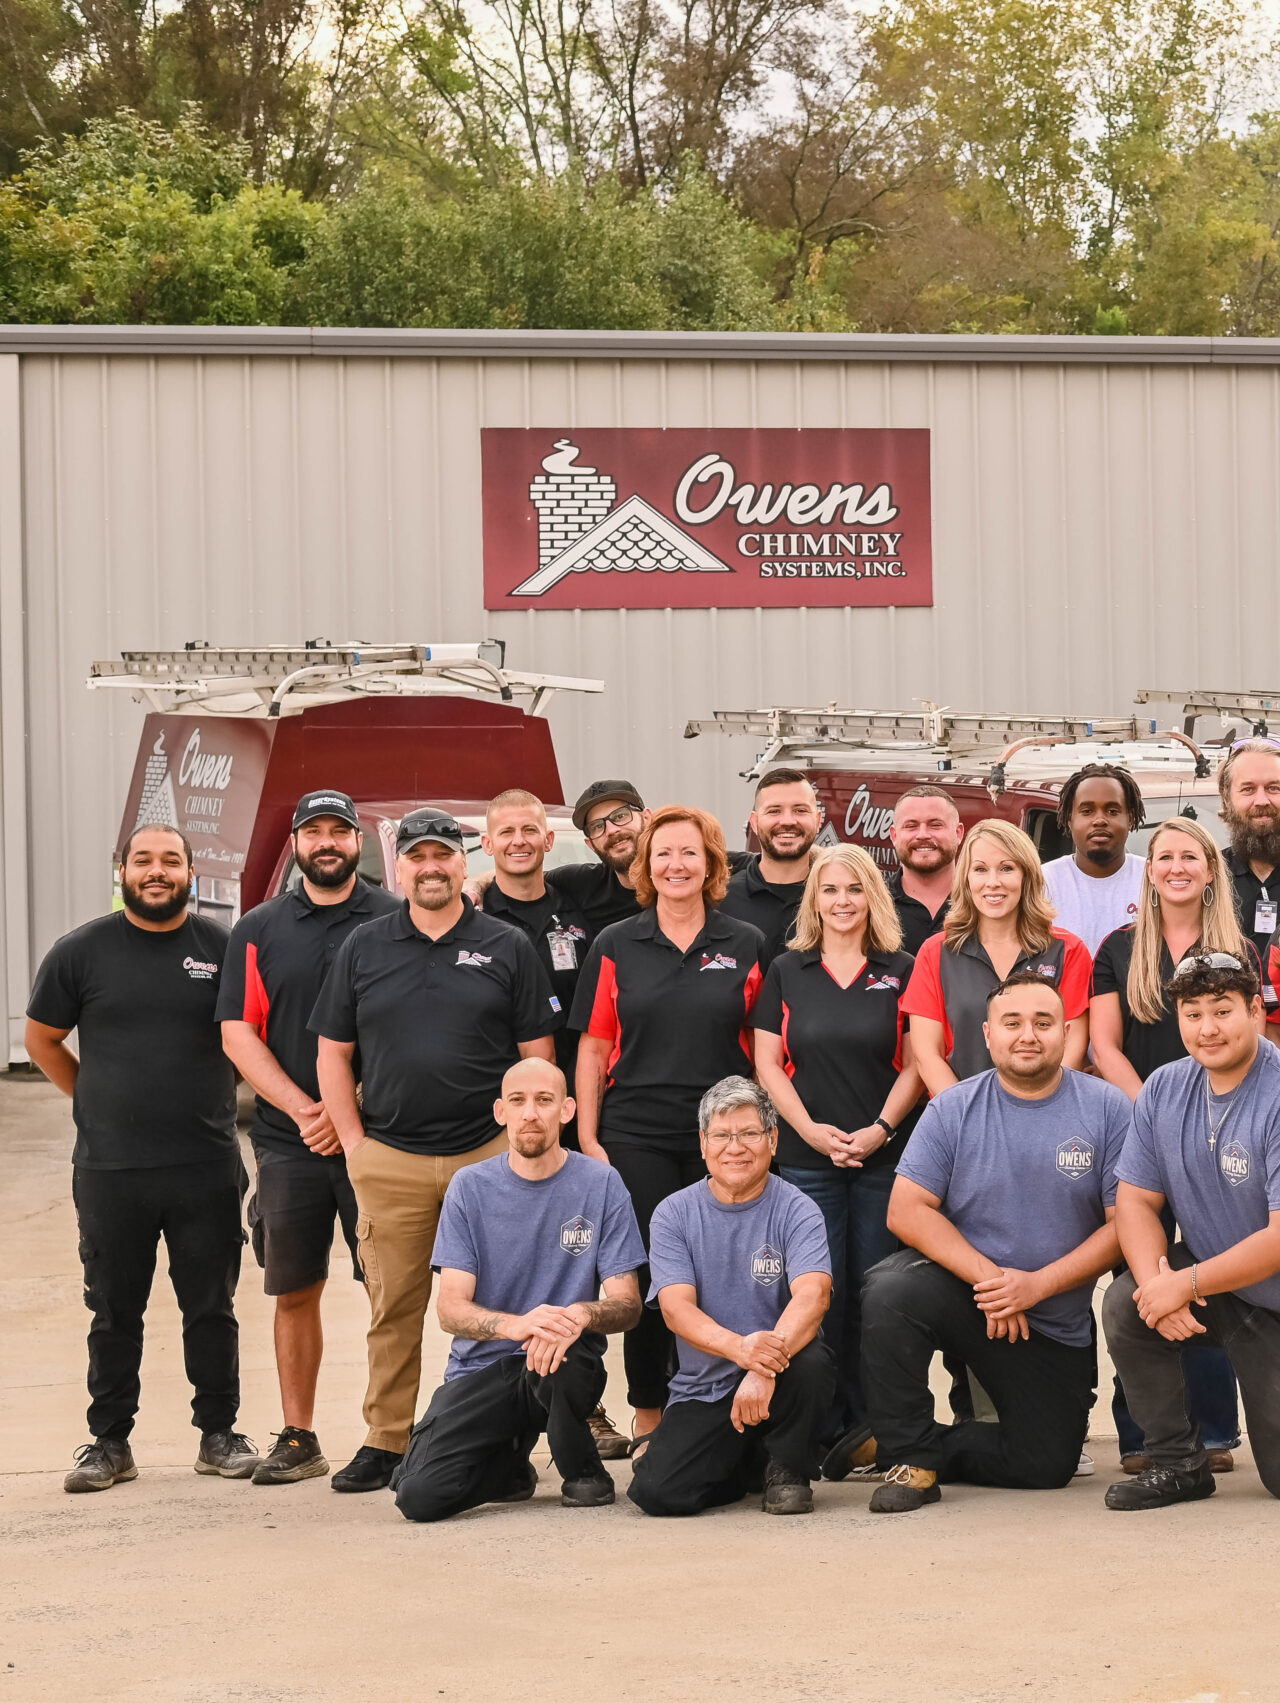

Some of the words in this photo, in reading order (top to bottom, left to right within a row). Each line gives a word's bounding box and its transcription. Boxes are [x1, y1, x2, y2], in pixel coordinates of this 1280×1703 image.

[674, 452, 899, 526] Owens
[737, 532, 902, 557] CHIMNEY
[178, 727, 234, 790] Owens
[184, 795, 225, 817] CHIMNEY
[844, 783, 895, 840] Owe
[1059, 1151, 1092, 1167] OWENS
[1222, 1154, 1248, 1175] OWENS
[562, 1229, 592, 1245] OWENS
[753, 1258, 781, 1274] OWENS
